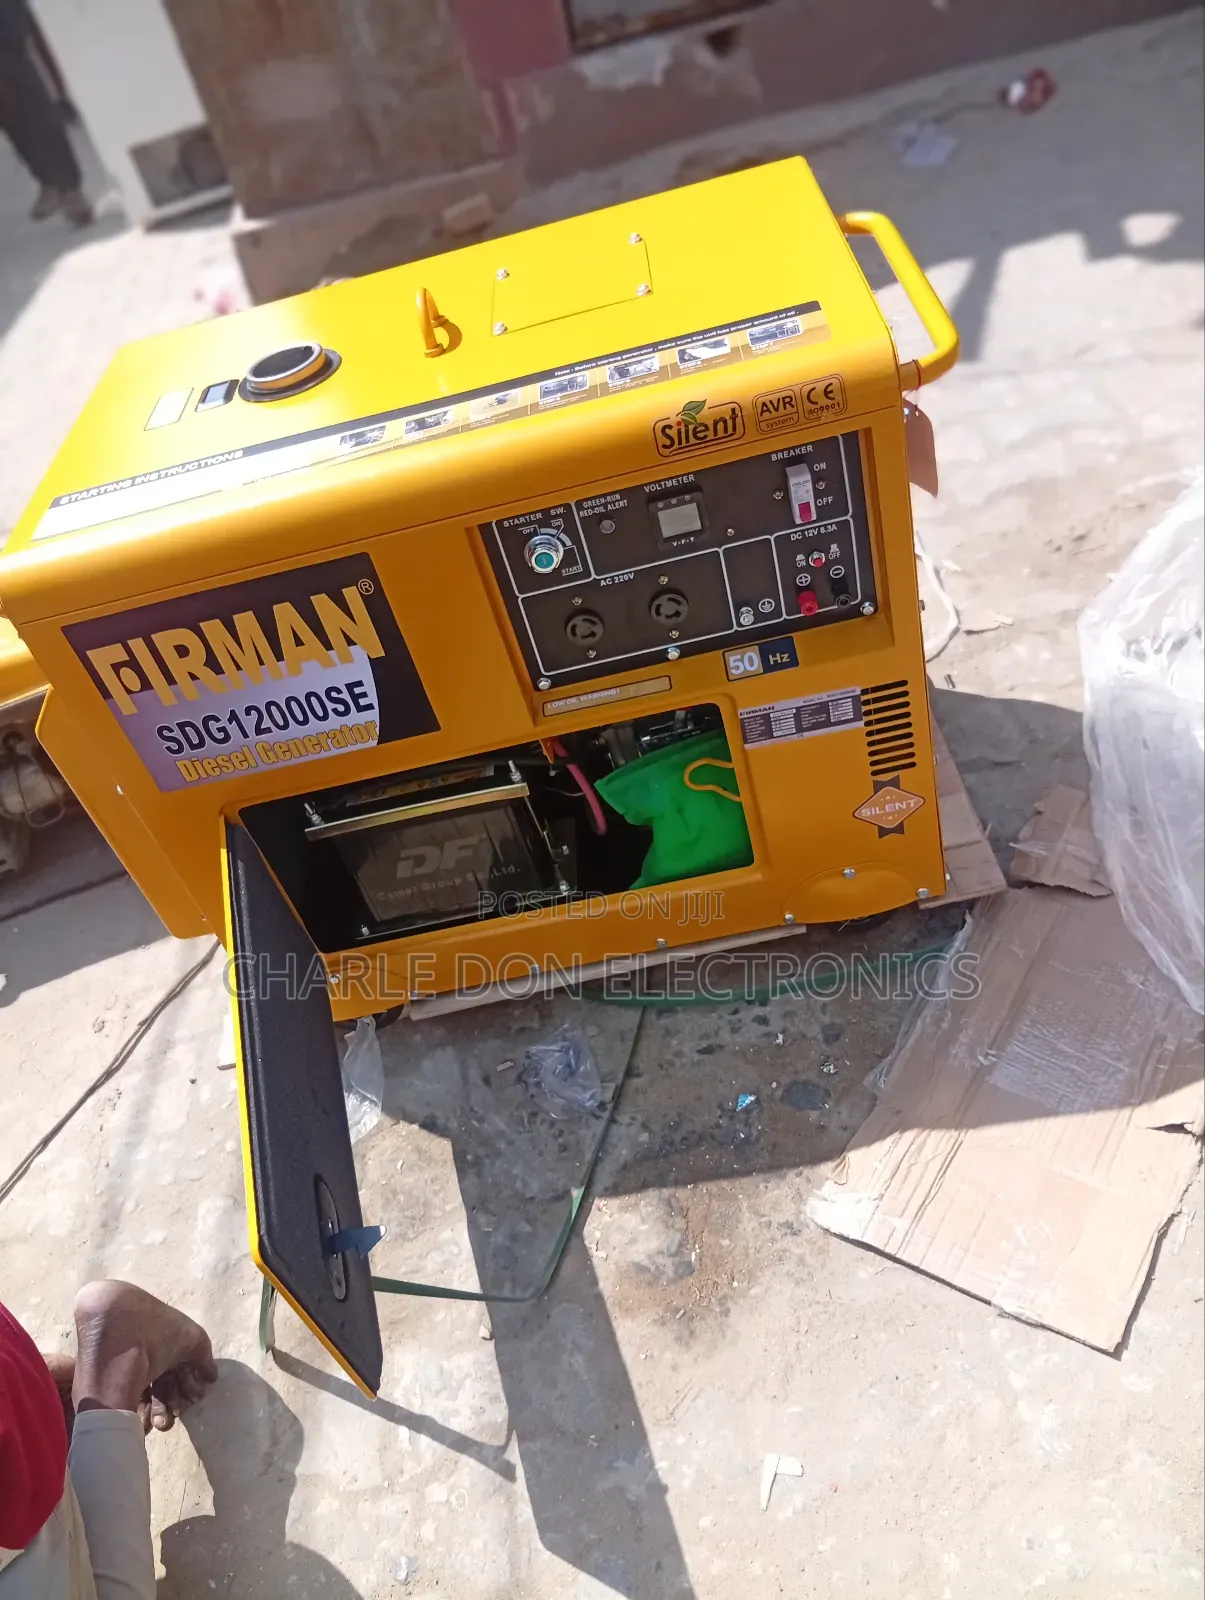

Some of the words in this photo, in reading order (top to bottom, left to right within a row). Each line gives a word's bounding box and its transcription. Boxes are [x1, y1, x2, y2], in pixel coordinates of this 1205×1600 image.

[759, 395, 795, 417] AVR
[661, 407, 739, 450] Silent
[765, 416, 794, 429] system
[771, 445, 814, 462] BREAKER
[813, 461, 826, 471] ON
[59, 479, 132, 505] STARTING
[135, 450, 244, 485] INSTRUCTIONS
[643, 474, 695, 493] VOLTMETER
[579, 505, 606, 518] RED-OIL
[607, 499, 628, 512] ALERT
[582, 493, 621, 509] GREEN-RUN
[816, 496, 834, 507] OFF
[503, 512, 543, 528] STARTER
[522, 527, 534, 535] OFF
[790, 532, 803, 541] DC
[804, 527, 819, 538] 12V
[820, 523, 838, 534] 8.3A
[796, 559, 806, 568] ON
[828, 551, 841, 560] OFF
[561, 565, 581, 575] START
[600, 577, 612, 587] AC
[613, 572, 635, 584] 220V
[86, 586, 385, 716] FIRMAN
[728, 651, 759, 675] 50
[768, 652, 790, 666] Hz
[156, 679, 376, 755] SDG12000SE
[175, 746, 258, 783] Diesel
[257, 720, 378, 765] Generator
[860, 799, 918, 818] SILENT
[421, 878, 463, 891] Group
